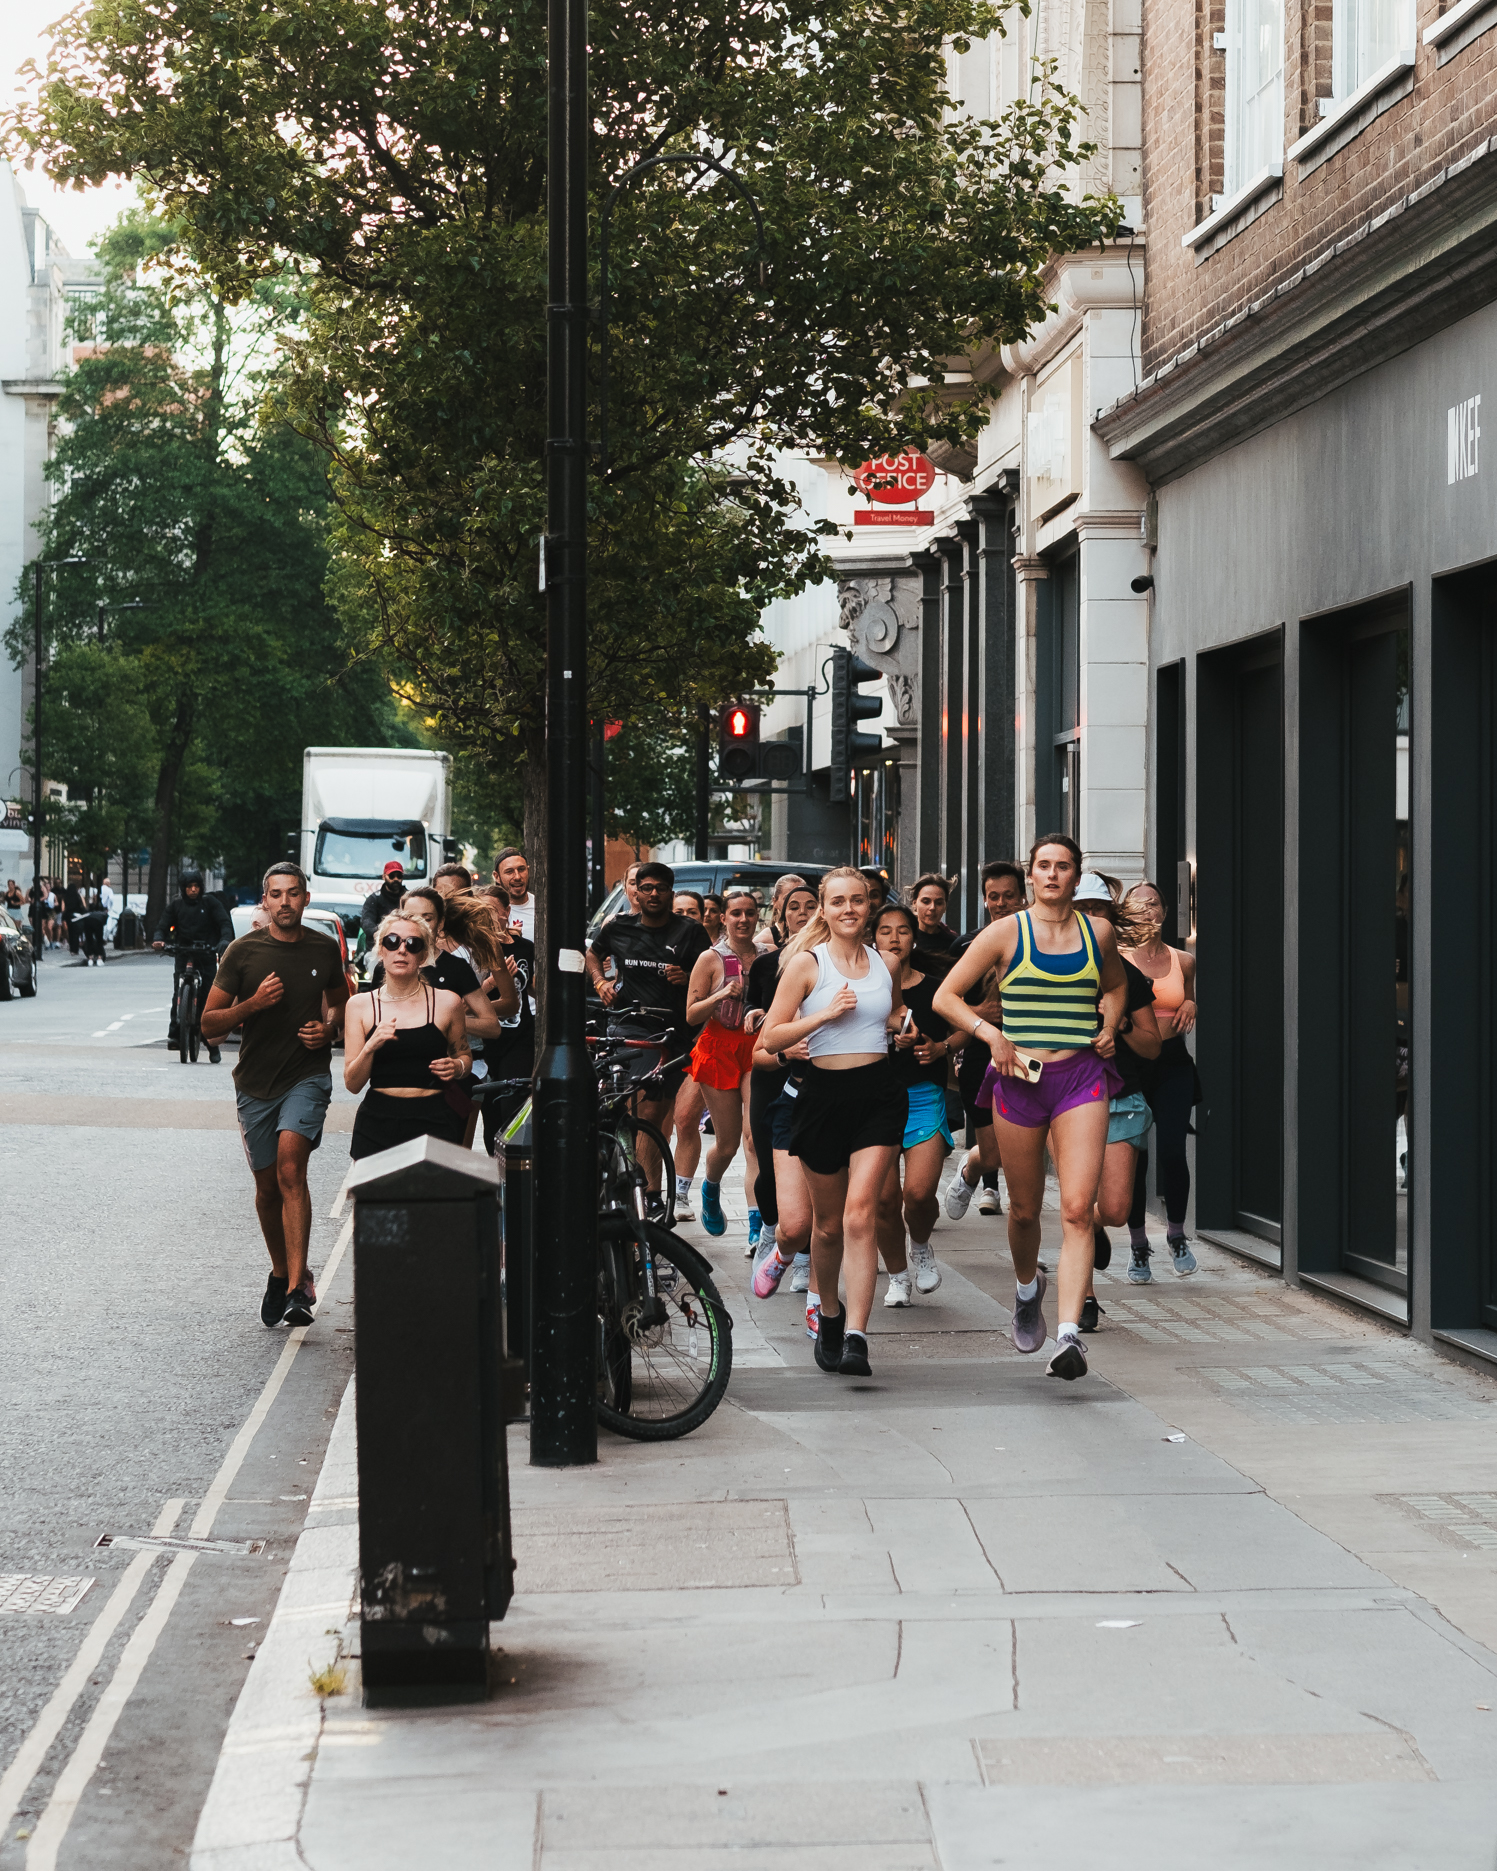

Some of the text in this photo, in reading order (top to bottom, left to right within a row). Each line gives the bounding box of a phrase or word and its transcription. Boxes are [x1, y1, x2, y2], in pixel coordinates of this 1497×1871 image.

[871, 453, 920, 470] POST
[870, 514, 919, 524] Travel Money
[0, 818, 28, 831] ving
[624, 958, 668, 970] RUN YOUR CIT
